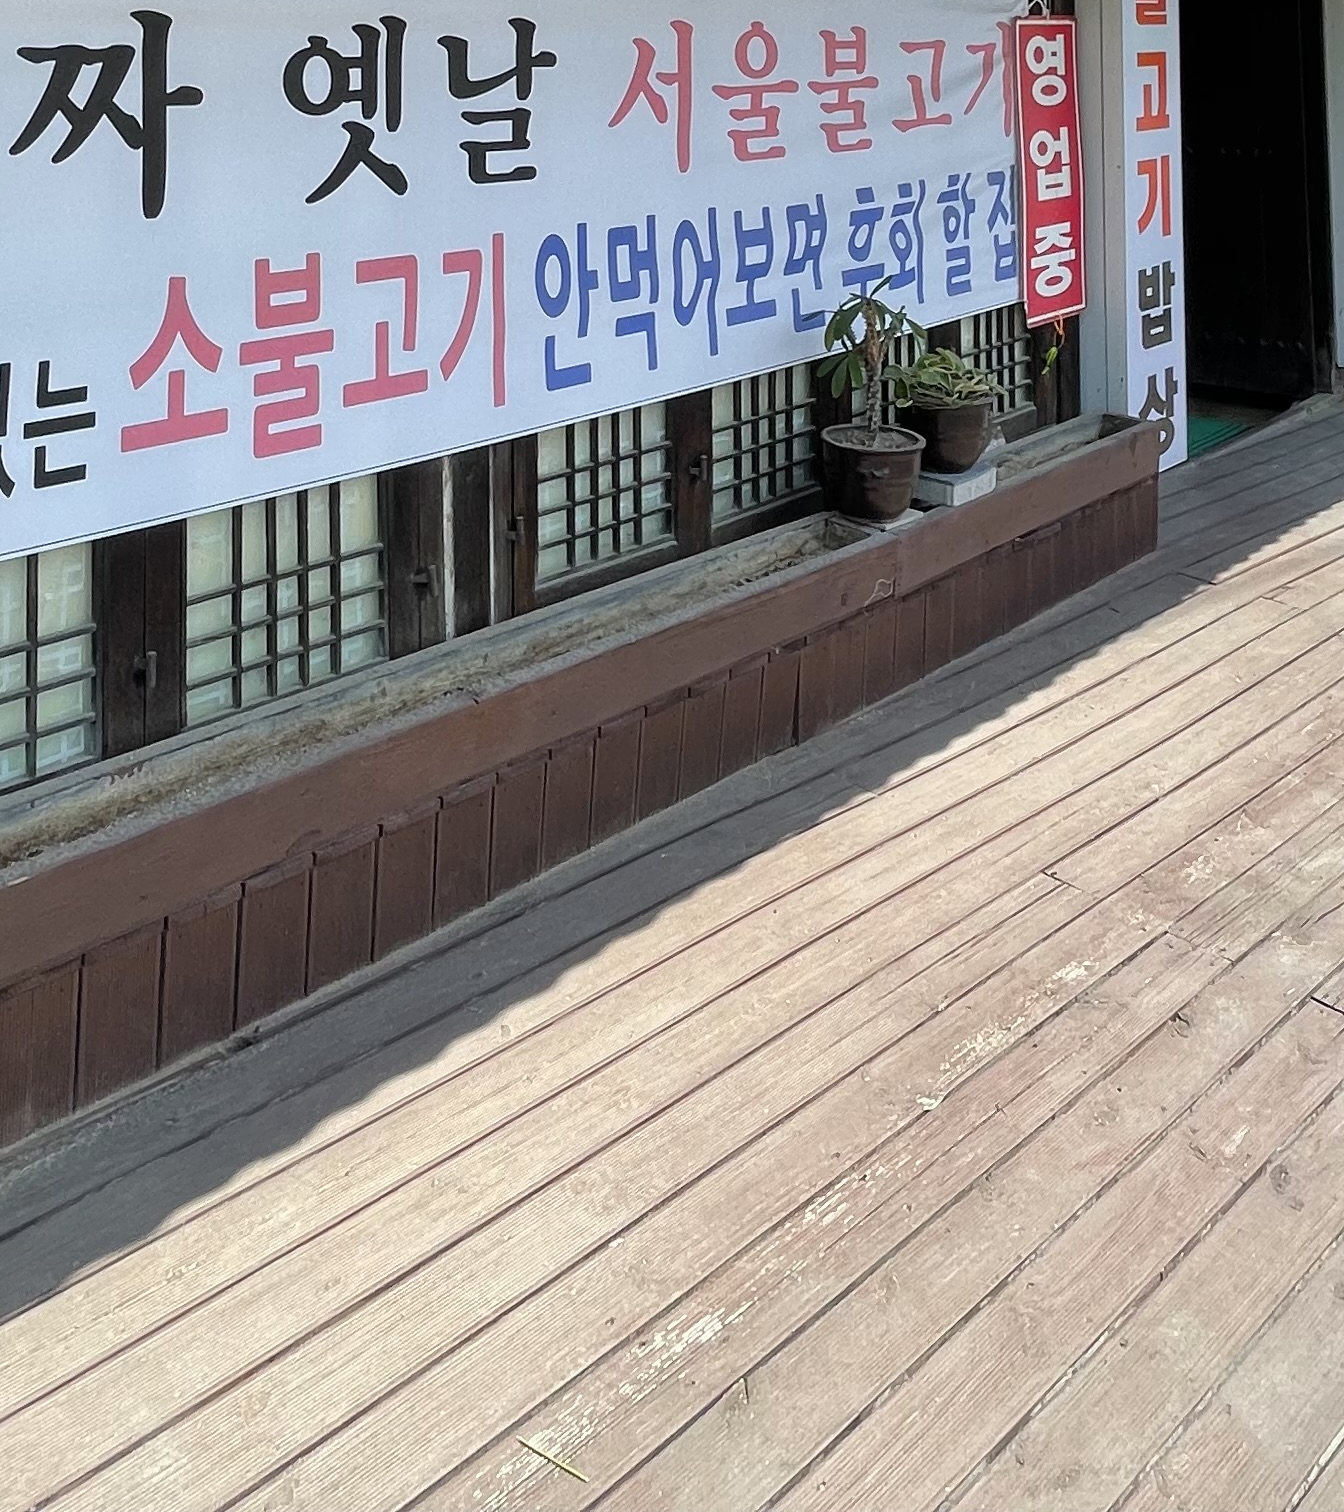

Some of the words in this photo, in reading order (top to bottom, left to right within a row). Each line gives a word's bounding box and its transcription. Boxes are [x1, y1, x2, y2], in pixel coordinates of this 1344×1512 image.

[282, 15, 558, 205] 옛날
[608, 19, 1013, 174] 서울불고기
[1024, 34, 1076, 298] 영업중
[120, 232, 508, 458] 소불고기
